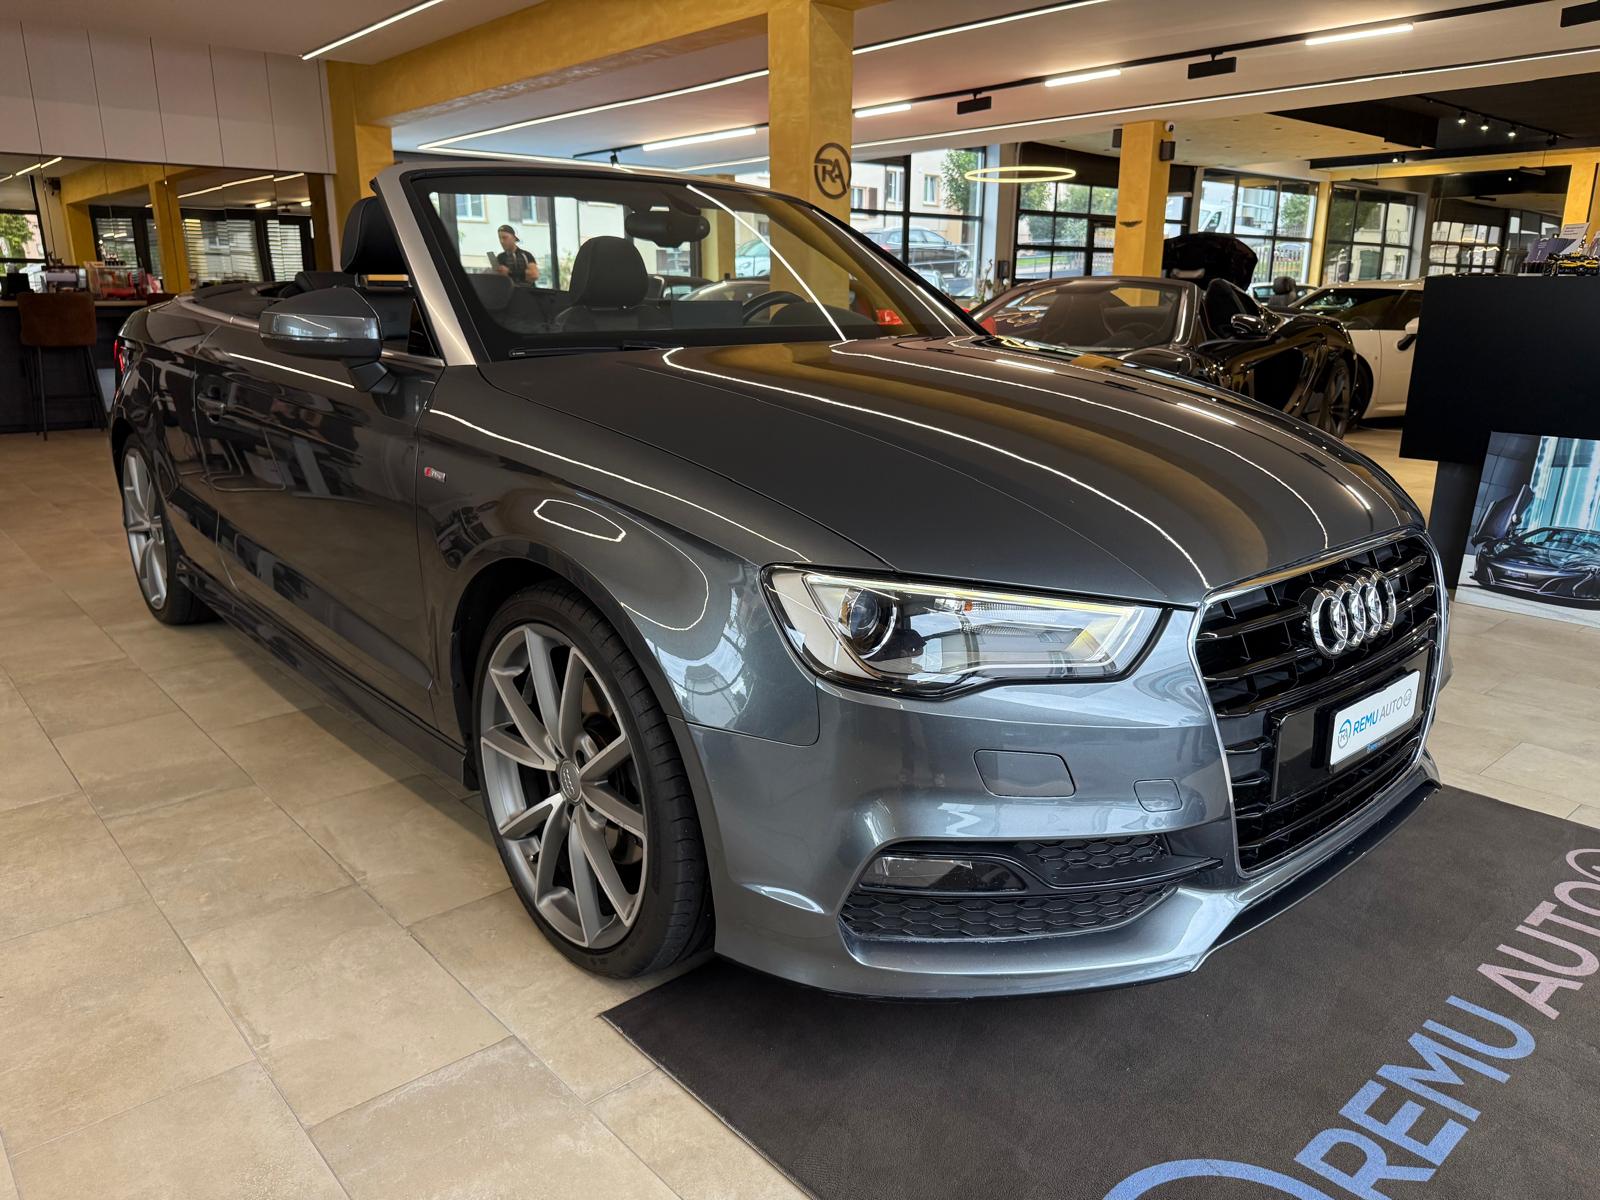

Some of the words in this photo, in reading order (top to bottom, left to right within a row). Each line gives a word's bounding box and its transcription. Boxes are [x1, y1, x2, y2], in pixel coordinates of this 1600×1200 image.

[1353, 708, 1379, 736] REMU
[1379, 696, 1403, 721] AUTO
[1294, 995, 1536, 1200] REMU
